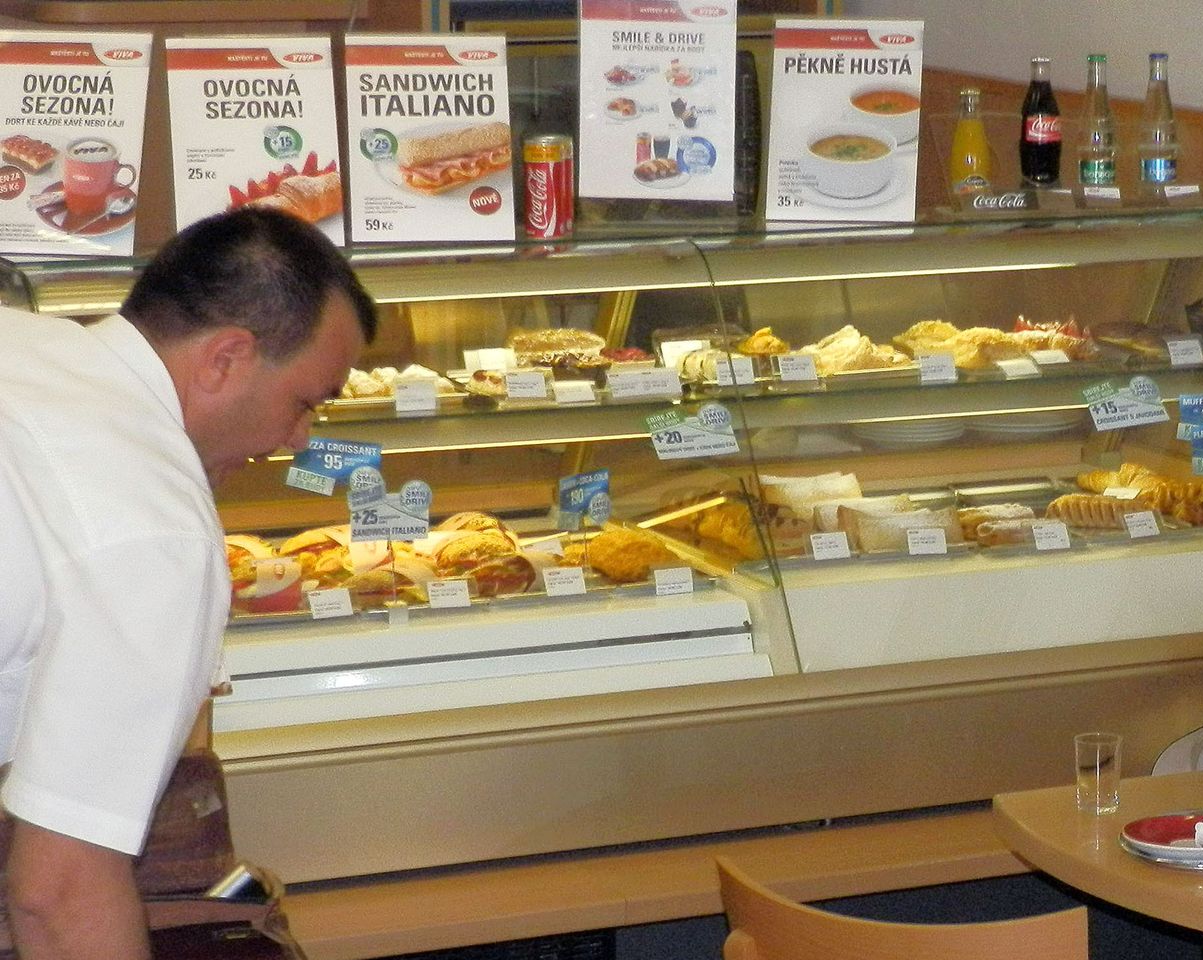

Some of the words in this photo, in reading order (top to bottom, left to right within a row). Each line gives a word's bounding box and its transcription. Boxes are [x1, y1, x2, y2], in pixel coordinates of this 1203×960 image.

[612, 31, 651, 43] SMILE
[655, 32, 664, 43] &
[669, 32, 704, 44] DRIVE
[887, 36, 907, 45] VIVA
[112, 50, 135, 59] VIVA
[291, 54, 315, 62] VIVA
[466, 51, 489, 60] VIVA
[784, 53, 844, 75] PĚKNĚ
[850, 54, 912, 75] HUSTÁ
[23, 70, 114, 95] OVOCNÁ
[203, 74, 301, 98] OVOCNÁ
[359, 73, 494, 92] SANDWICH
[20, 96, 114, 116] SEZONA!
[205, 100, 303, 120] SEZONA!
[360, 94, 496, 117] ITALIANO
[27, 118, 37, 126] KE
[84, 119, 106, 128] NEBO
[188, 168, 203, 180] 25
[205, 171, 217, 180] Kč
[777, 195, 791, 207] 35
[365, 219, 380, 231] 59
[382, 220, 394, 231] Kč
[654, 430, 683, 445] +20
[327, 442, 378, 457] CROISSANT
[323, 453, 343, 470] 95
[352, 527, 390, 538] SANDWICH
[391, 526, 427, 536] ITALIANO
